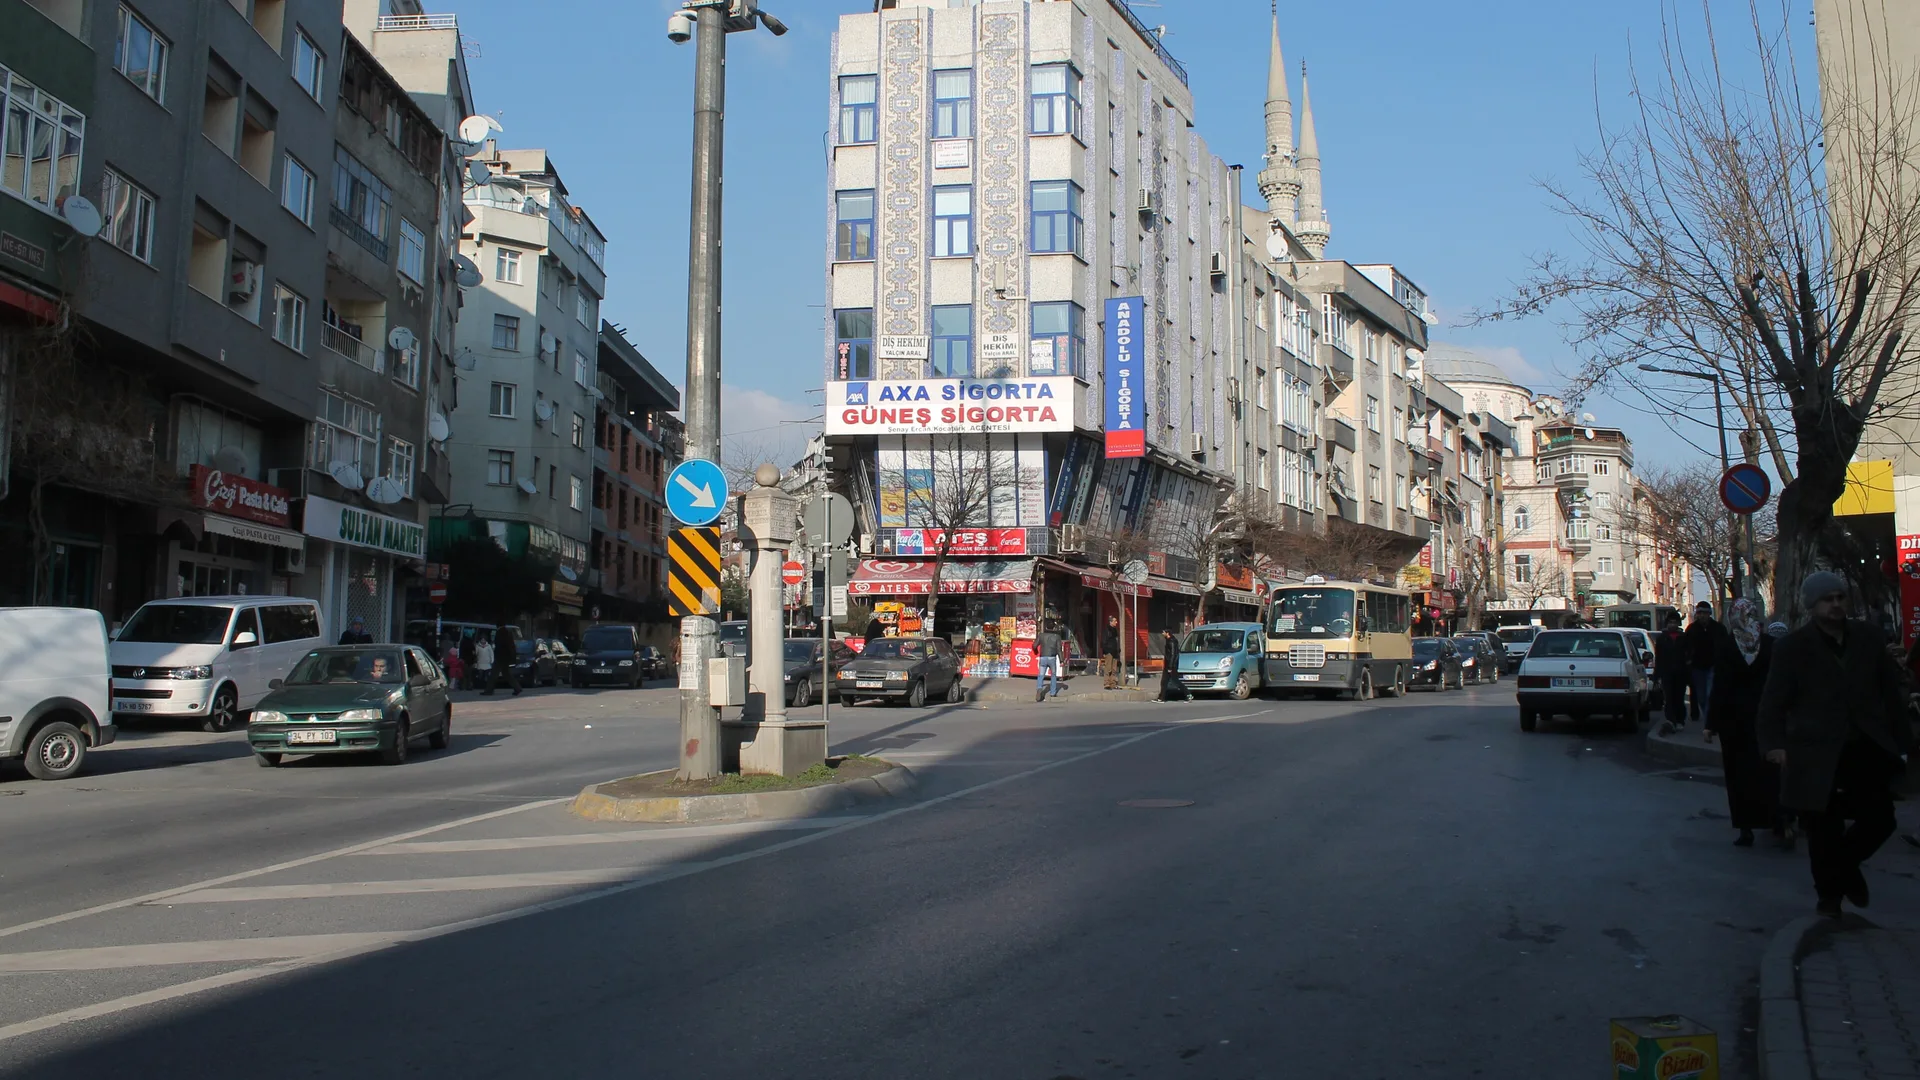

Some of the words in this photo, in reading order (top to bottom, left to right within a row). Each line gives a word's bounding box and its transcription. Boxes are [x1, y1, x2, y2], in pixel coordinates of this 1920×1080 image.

[992, 335, 1008, 343] DİŞ
[1117, 302, 1131, 362] ANADOLU
[882, 336, 895, 348] DİŞ
[897, 336, 926, 348] HEKİMİ
[846, 393, 864, 403] AXA
[879, 385, 930, 401] AXA
[941, 380, 1054, 400] SİGORTA
[1117, 369, 1132, 429] SİGORTA
[842, 405, 931, 428] GÜNEŞ
[941, 403, 1057, 423] SİGORTA
[239, 486, 263, 509] Pasta
[262, 493, 270, 511] &
[270, 494, 288, 515] Cafe
[246, 528, 263, 540] PASTA
[268, 533, 281, 543] CAFE
[339, 508, 382, 547] SULTAN
[382, 518, 423, 557] MARKET
[935, 532, 988, 546] ATEŞ
[880, 583, 910, 593] ATEŞ
[292, 732, 302, 740] 34
[306, 732, 316, 740] PY
[321, 731, 334, 739] 103
[1662, 1053, 1704, 1078] Bizim
